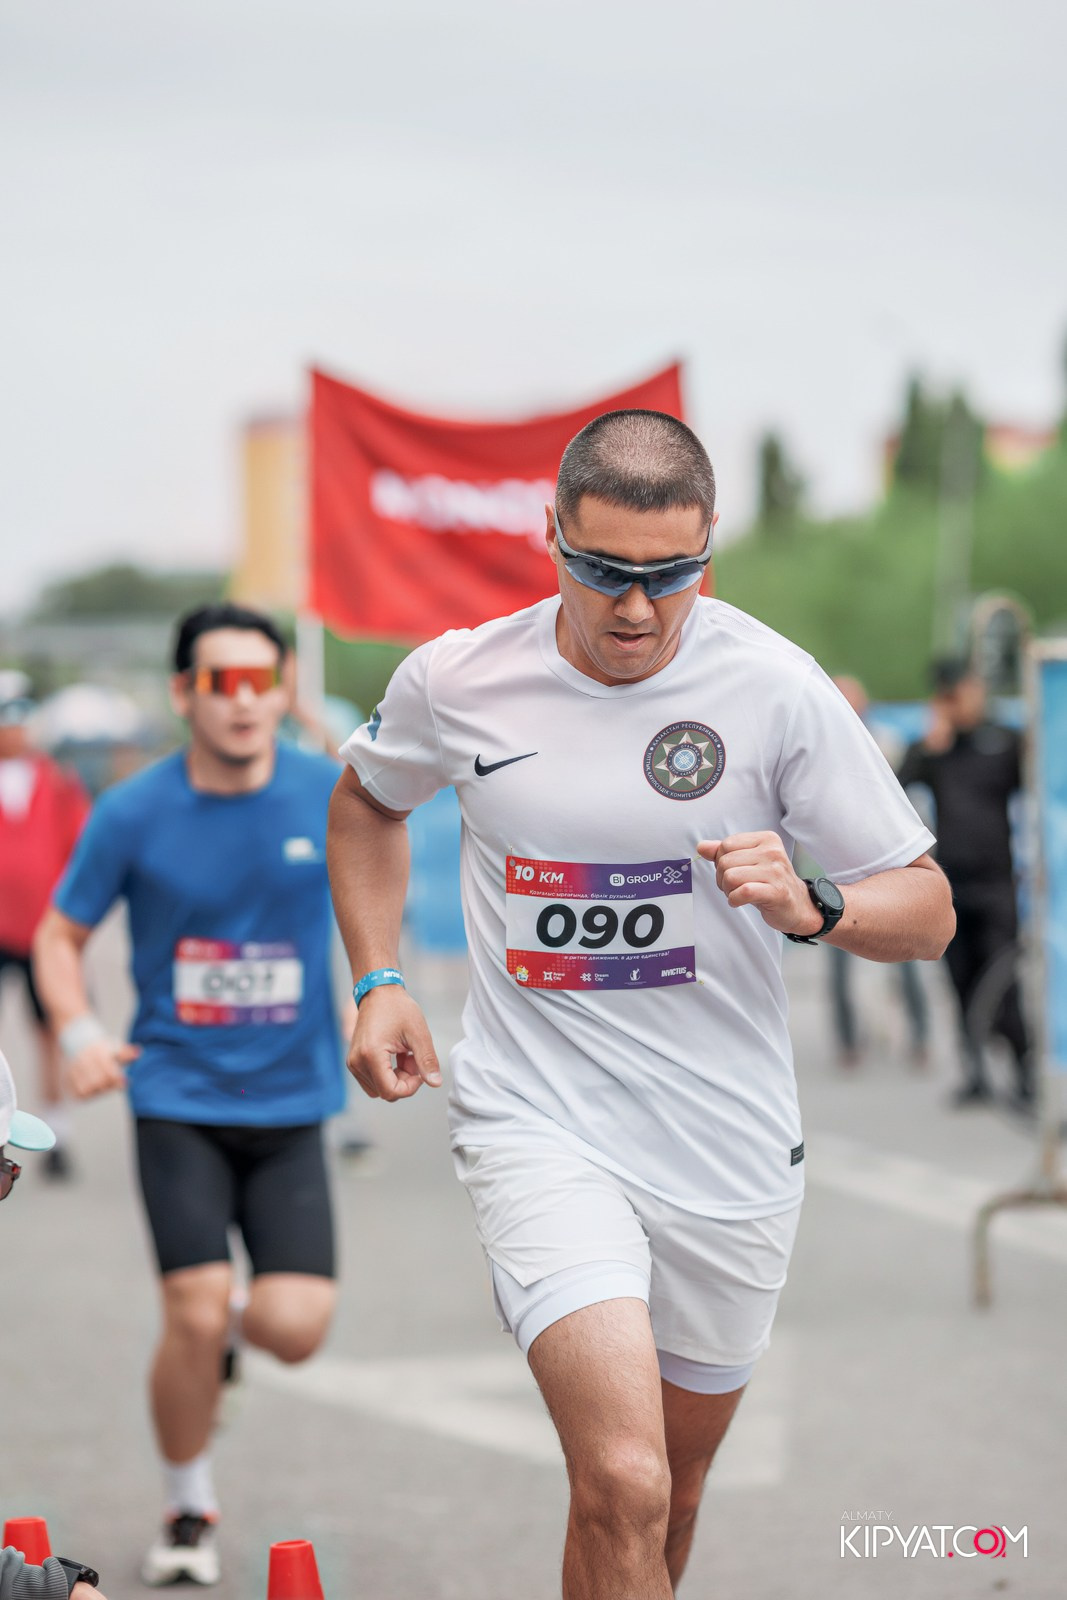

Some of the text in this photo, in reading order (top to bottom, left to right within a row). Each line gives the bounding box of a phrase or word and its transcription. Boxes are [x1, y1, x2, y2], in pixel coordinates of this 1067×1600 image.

[681, 723, 720, 743] РЕСПУБЛИКАСЫ
[514, 865, 535, 881] 10
[626, 872, 662, 884] GROUP
[536, 903, 665, 949] 090
[661, 966, 687, 978] INVICTUS
